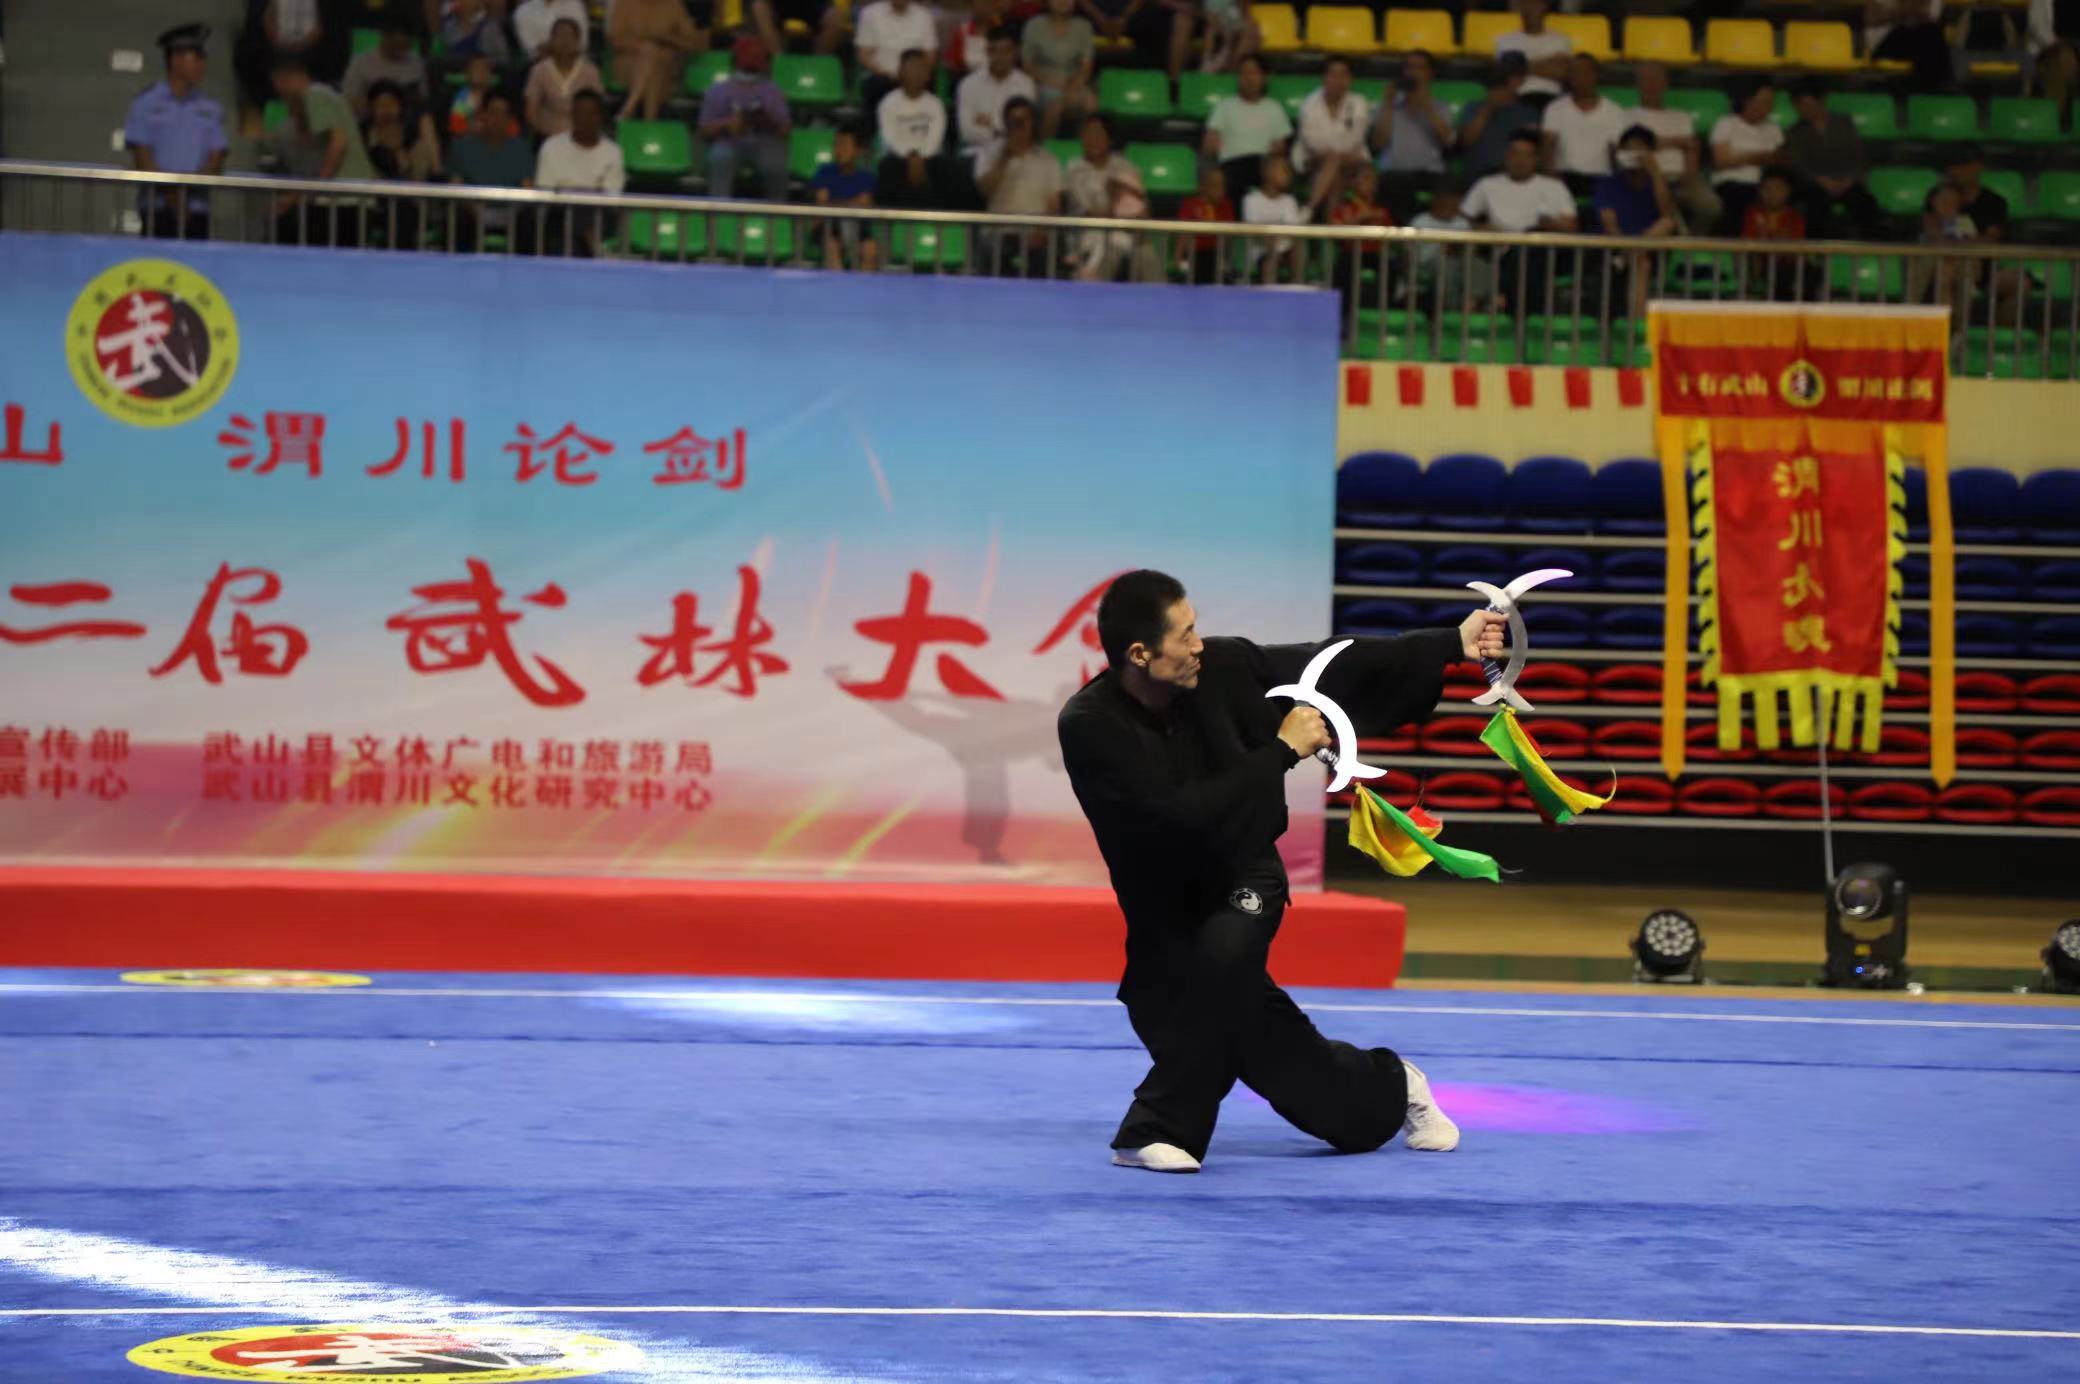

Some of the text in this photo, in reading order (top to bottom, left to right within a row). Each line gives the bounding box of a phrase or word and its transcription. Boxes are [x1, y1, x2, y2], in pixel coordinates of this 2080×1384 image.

[97, 292, 199, 391] 武
[0, 405, 747, 491] 山 渭川论剑
[0, 562, 309, 685] 二届
[0, 725, 713, 775] 宣传部 武山县文体广电和旅游局
[203, 767, 713, 811] 武山县渭川文化研究中心
